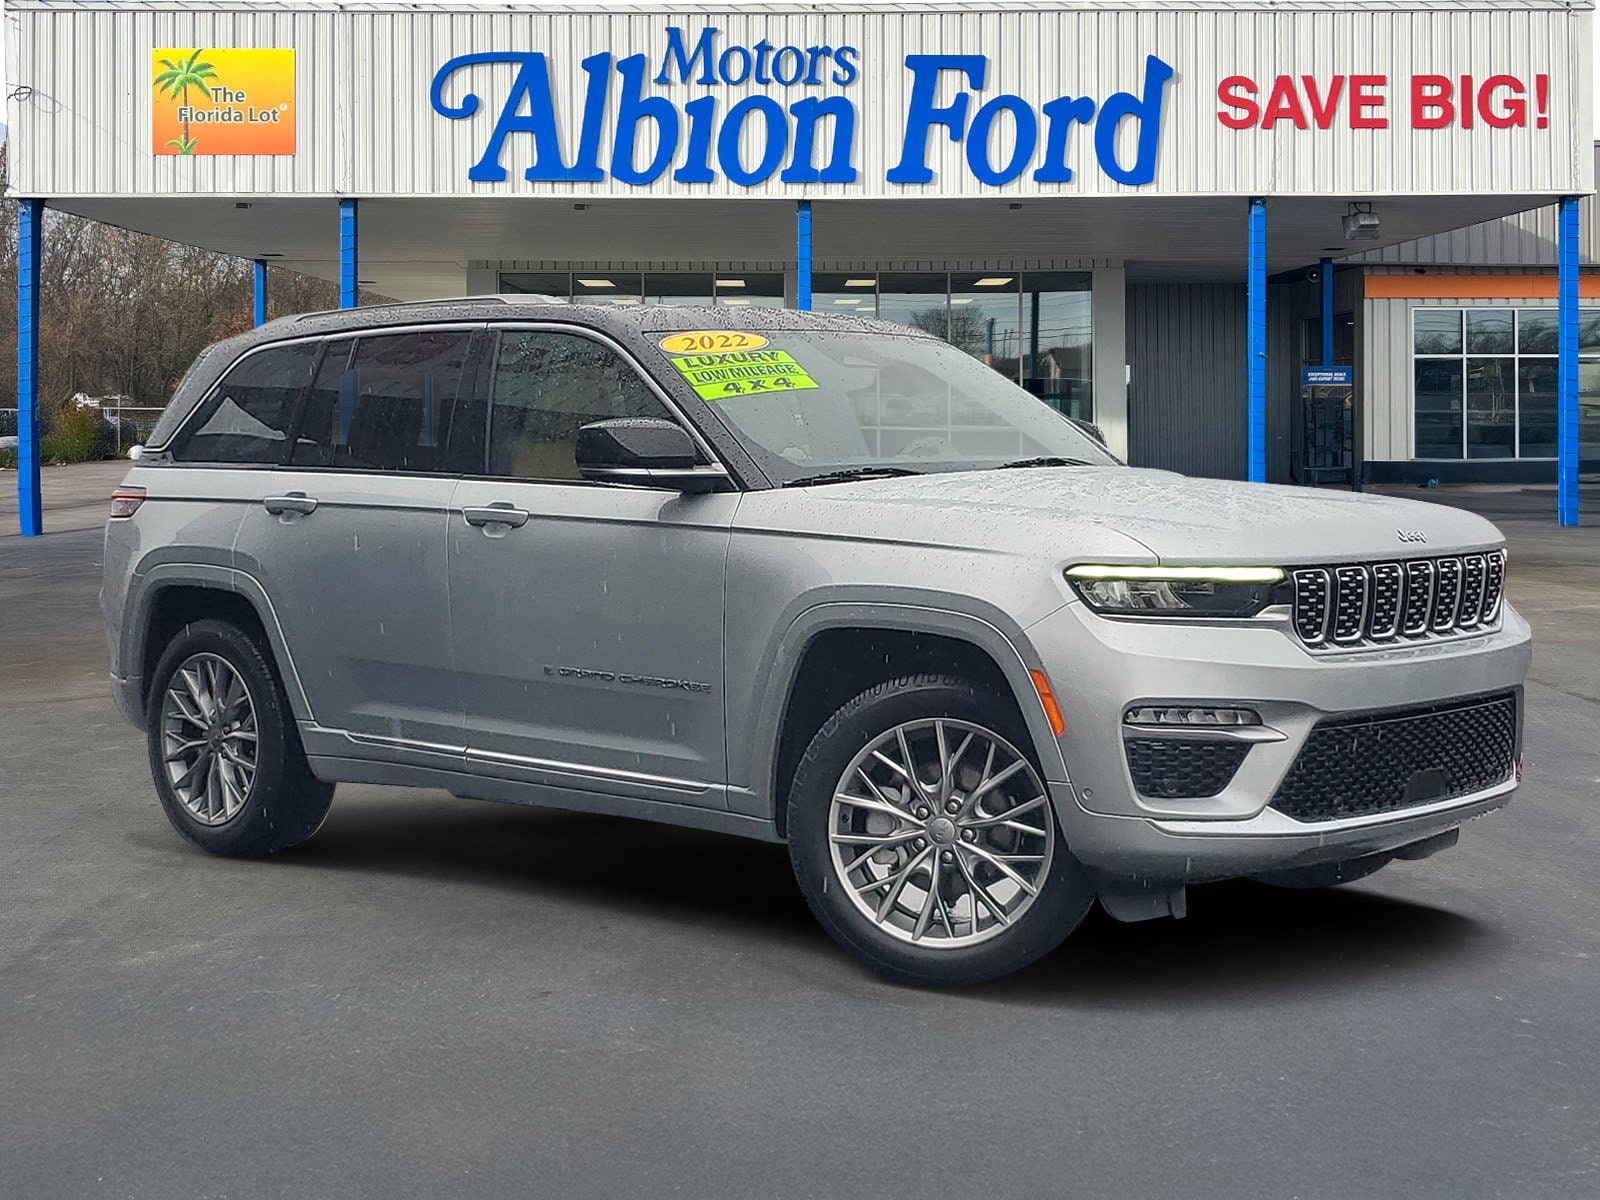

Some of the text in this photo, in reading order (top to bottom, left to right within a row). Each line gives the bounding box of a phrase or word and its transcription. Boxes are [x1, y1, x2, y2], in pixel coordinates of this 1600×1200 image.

[653, 27, 857, 85] Motors
[211, 87, 245, 103] The
[1217, 74, 1548, 129] SAVE BIG!
[178, 107, 279, 122] Florida Lot
[430, 51, 1174, 186] Albion Ford
[682, 335, 749, 351] 2022
[683, 351, 780, 368] LUXURY
[692, 363, 798, 383] LOW MILEAGE
[1397, 529, 1428, 544] Jeep
[619, 673, 712, 693] CHEROKEE
